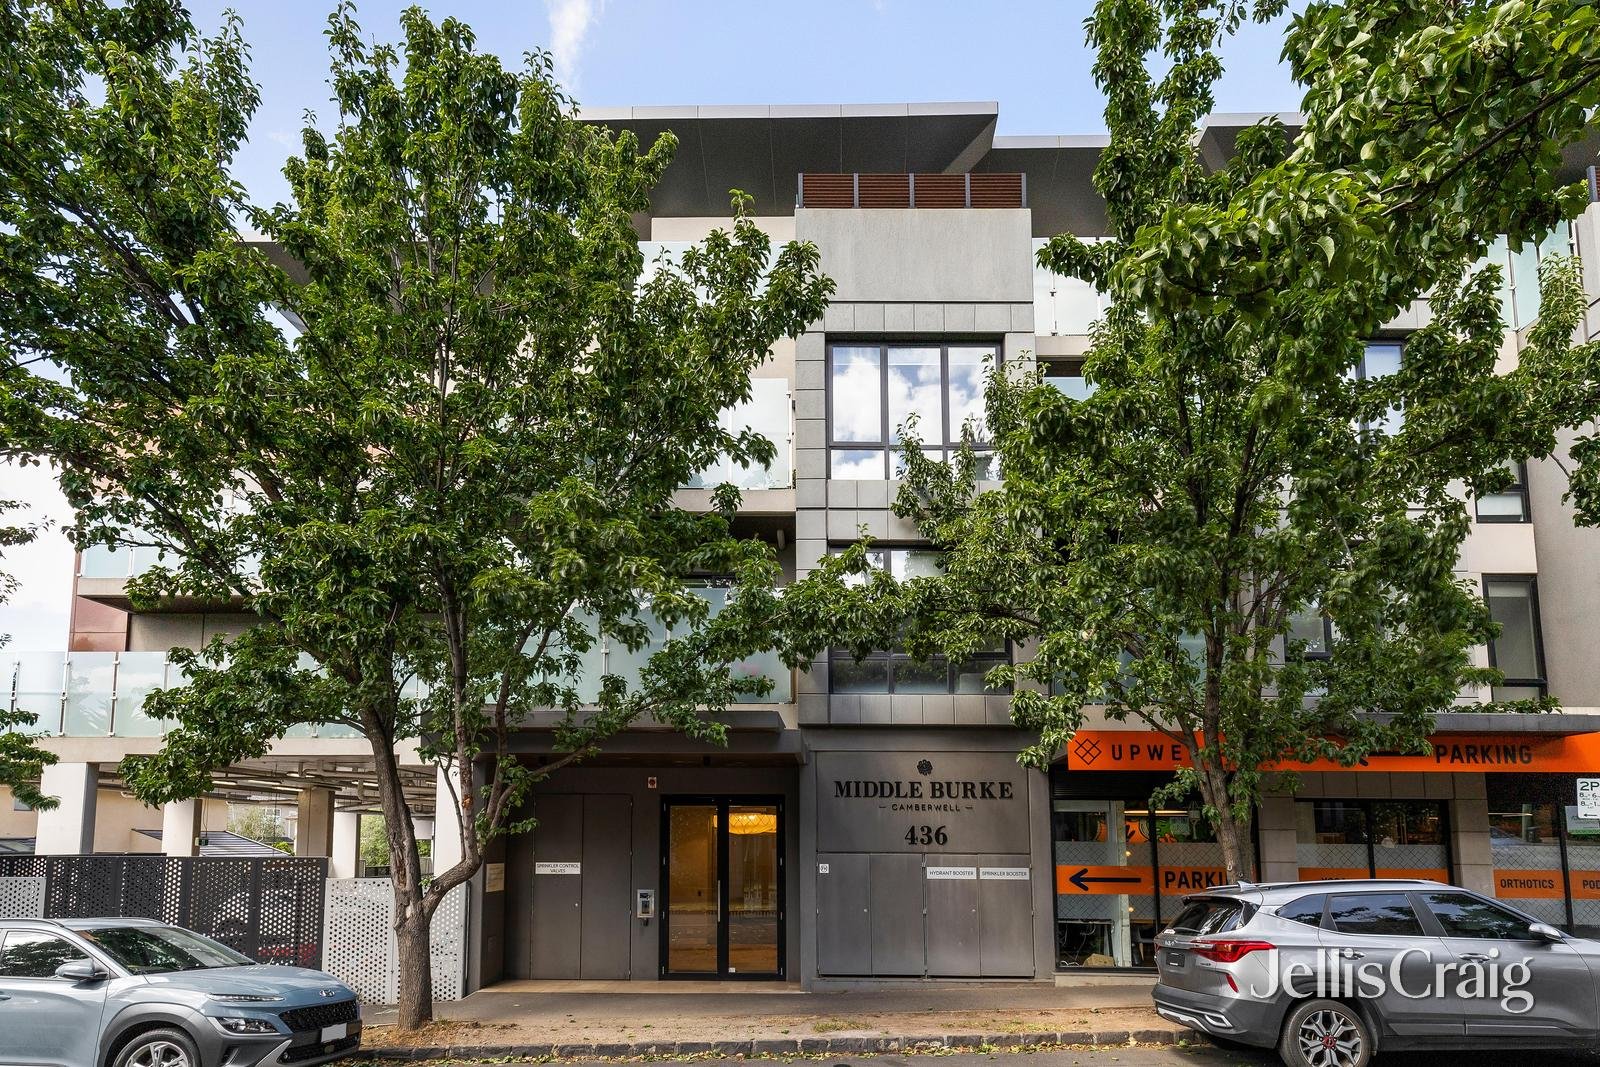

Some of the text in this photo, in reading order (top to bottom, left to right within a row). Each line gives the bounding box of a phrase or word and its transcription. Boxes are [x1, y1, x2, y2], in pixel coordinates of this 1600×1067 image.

[1111, 744, 1193, 761] UPWE
[1436, 744, 1533, 764] PARKING
[834, 780, 1013, 799] MIDDLE BURKE
[891, 803, 961, 812] CAMBERWELL
[904, 825, 948, 846] 436
[1500, 879, 1554, 889] ORTHOTICS
